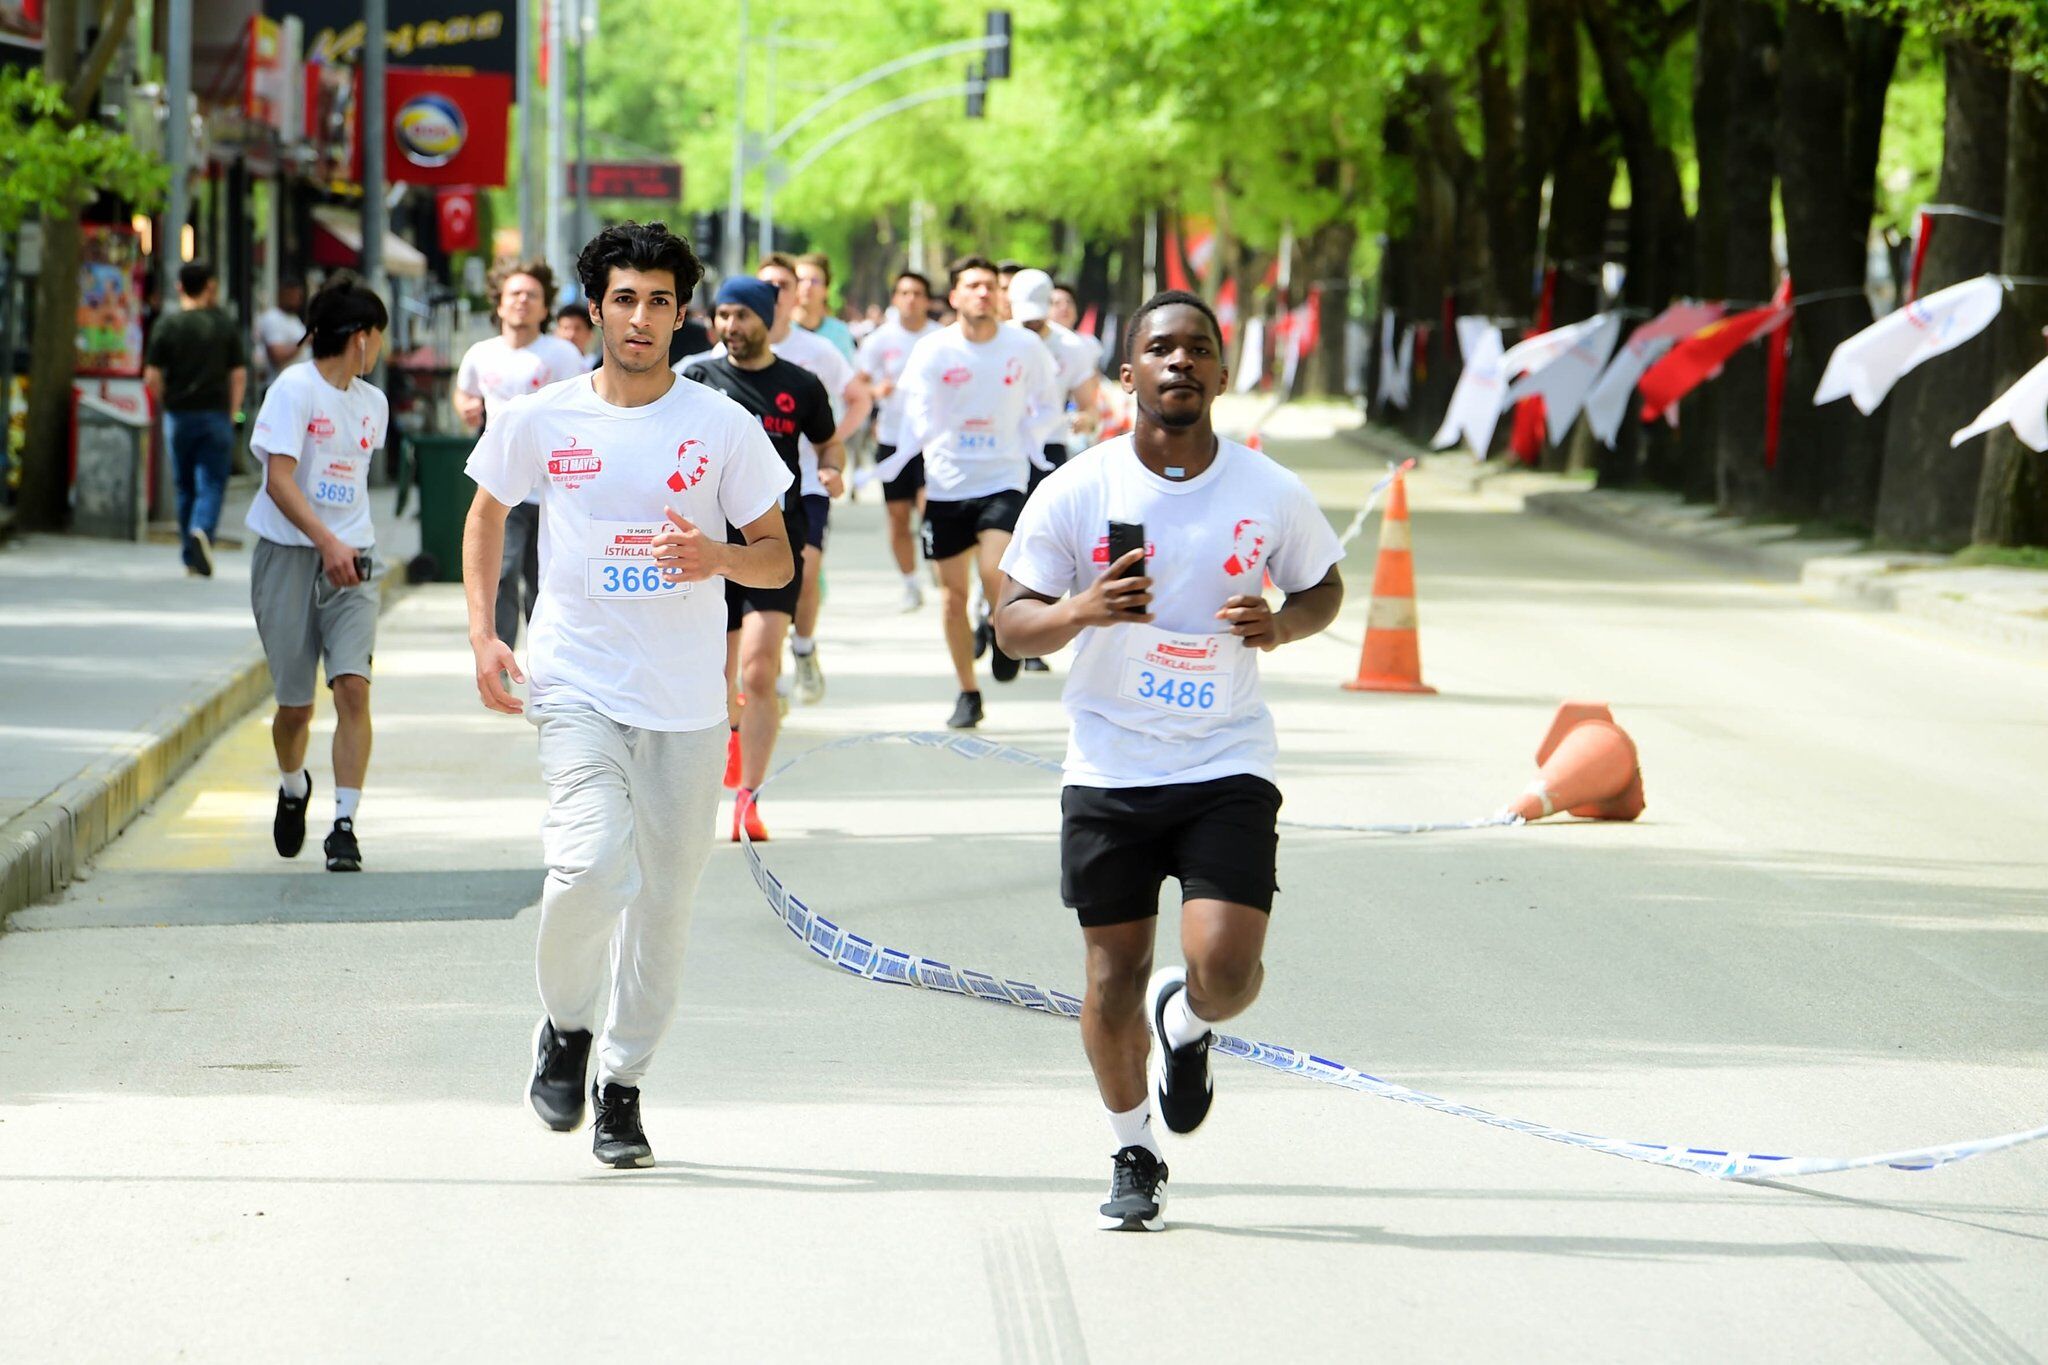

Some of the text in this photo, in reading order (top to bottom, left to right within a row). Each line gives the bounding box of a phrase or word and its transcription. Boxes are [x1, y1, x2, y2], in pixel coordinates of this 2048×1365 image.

[559, 457, 599, 472] 19 MAYIS
[316, 480, 355, 504] 3693
[1138, 671, 1215, 709] 3486
